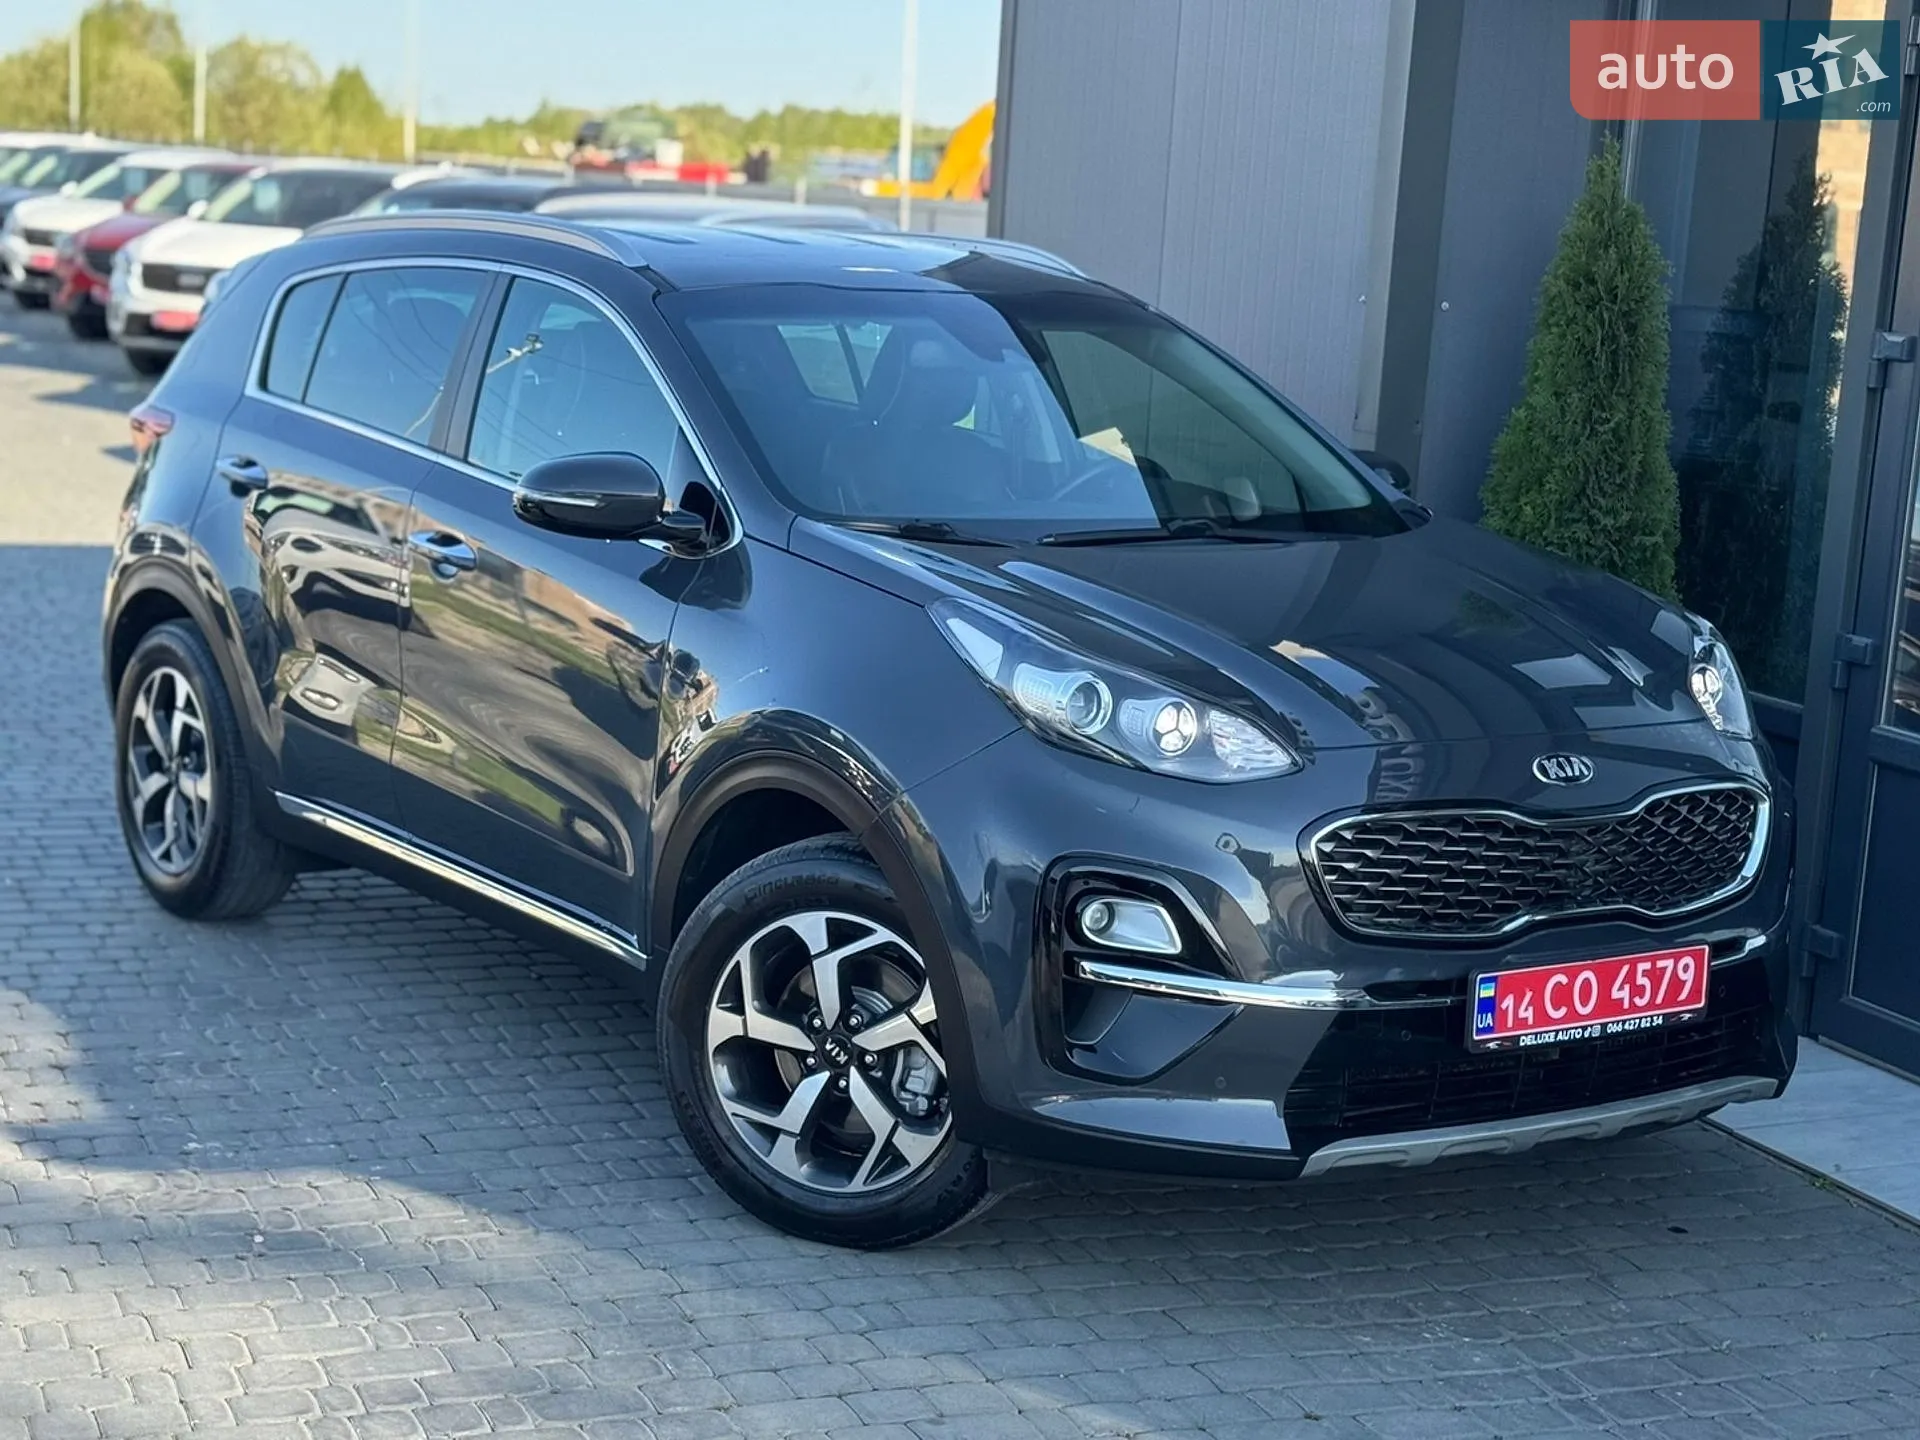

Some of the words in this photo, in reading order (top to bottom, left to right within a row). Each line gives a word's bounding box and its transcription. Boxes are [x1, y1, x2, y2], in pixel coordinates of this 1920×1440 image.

[1541, 757, 1589, 779] KIA
[1500, 988, 1535, 1028] 14
[1543, 970, 1599, 1019] CO
[1611, 955, 1695, 1010] 4579
[1477, 1013, 1494, 1029] UA
[1519, 1032, 1555, 1046] DELUXE
[1556, 1028, 1582, 1041] AUTO
[1606, 1022, 1622, 1033] 066
[1624, 1019, 1639, 1031] 427
[1652, 1015, 1663, 1027] 34
[825, 1037, 848, 1065] KIA
